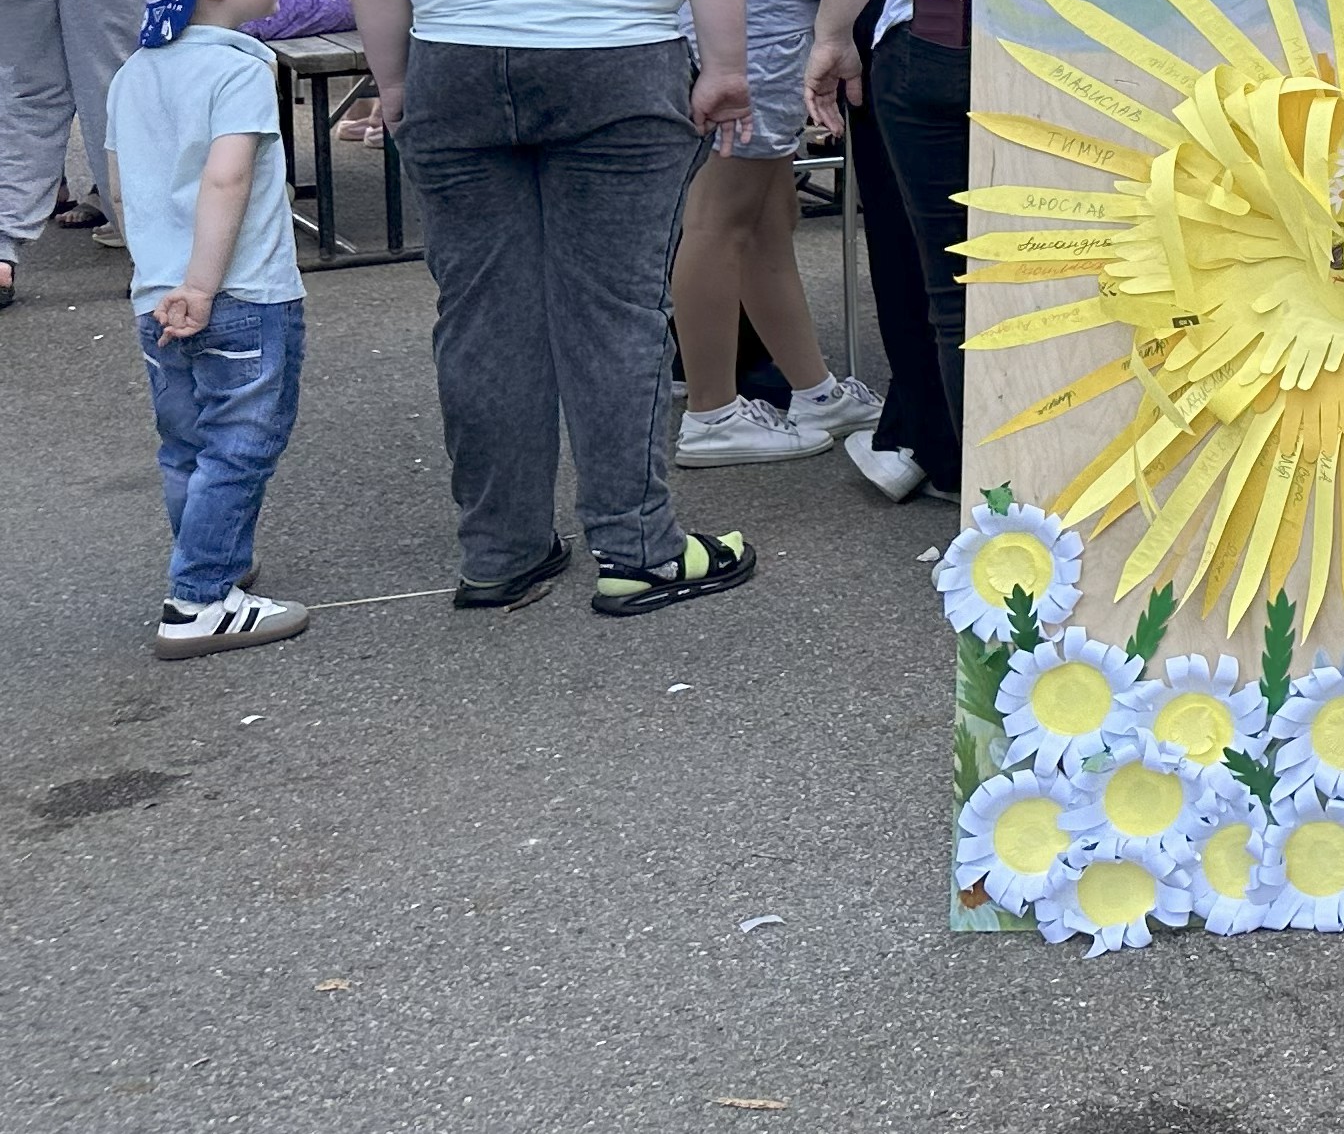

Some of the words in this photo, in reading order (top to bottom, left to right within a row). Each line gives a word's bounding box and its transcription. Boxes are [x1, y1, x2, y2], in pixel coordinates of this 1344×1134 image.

[1049, 64, 1143, 124] ВЛАДИСЛАВ
[1046, 130, 1116, 166] ТИМУР
[1022, 195, 1106, 219] ЯРОСЛАВ
[1179, 358, 1238, 417] ЛАДИСЛАВ
[1293, 466, 1312, 507] Вера
